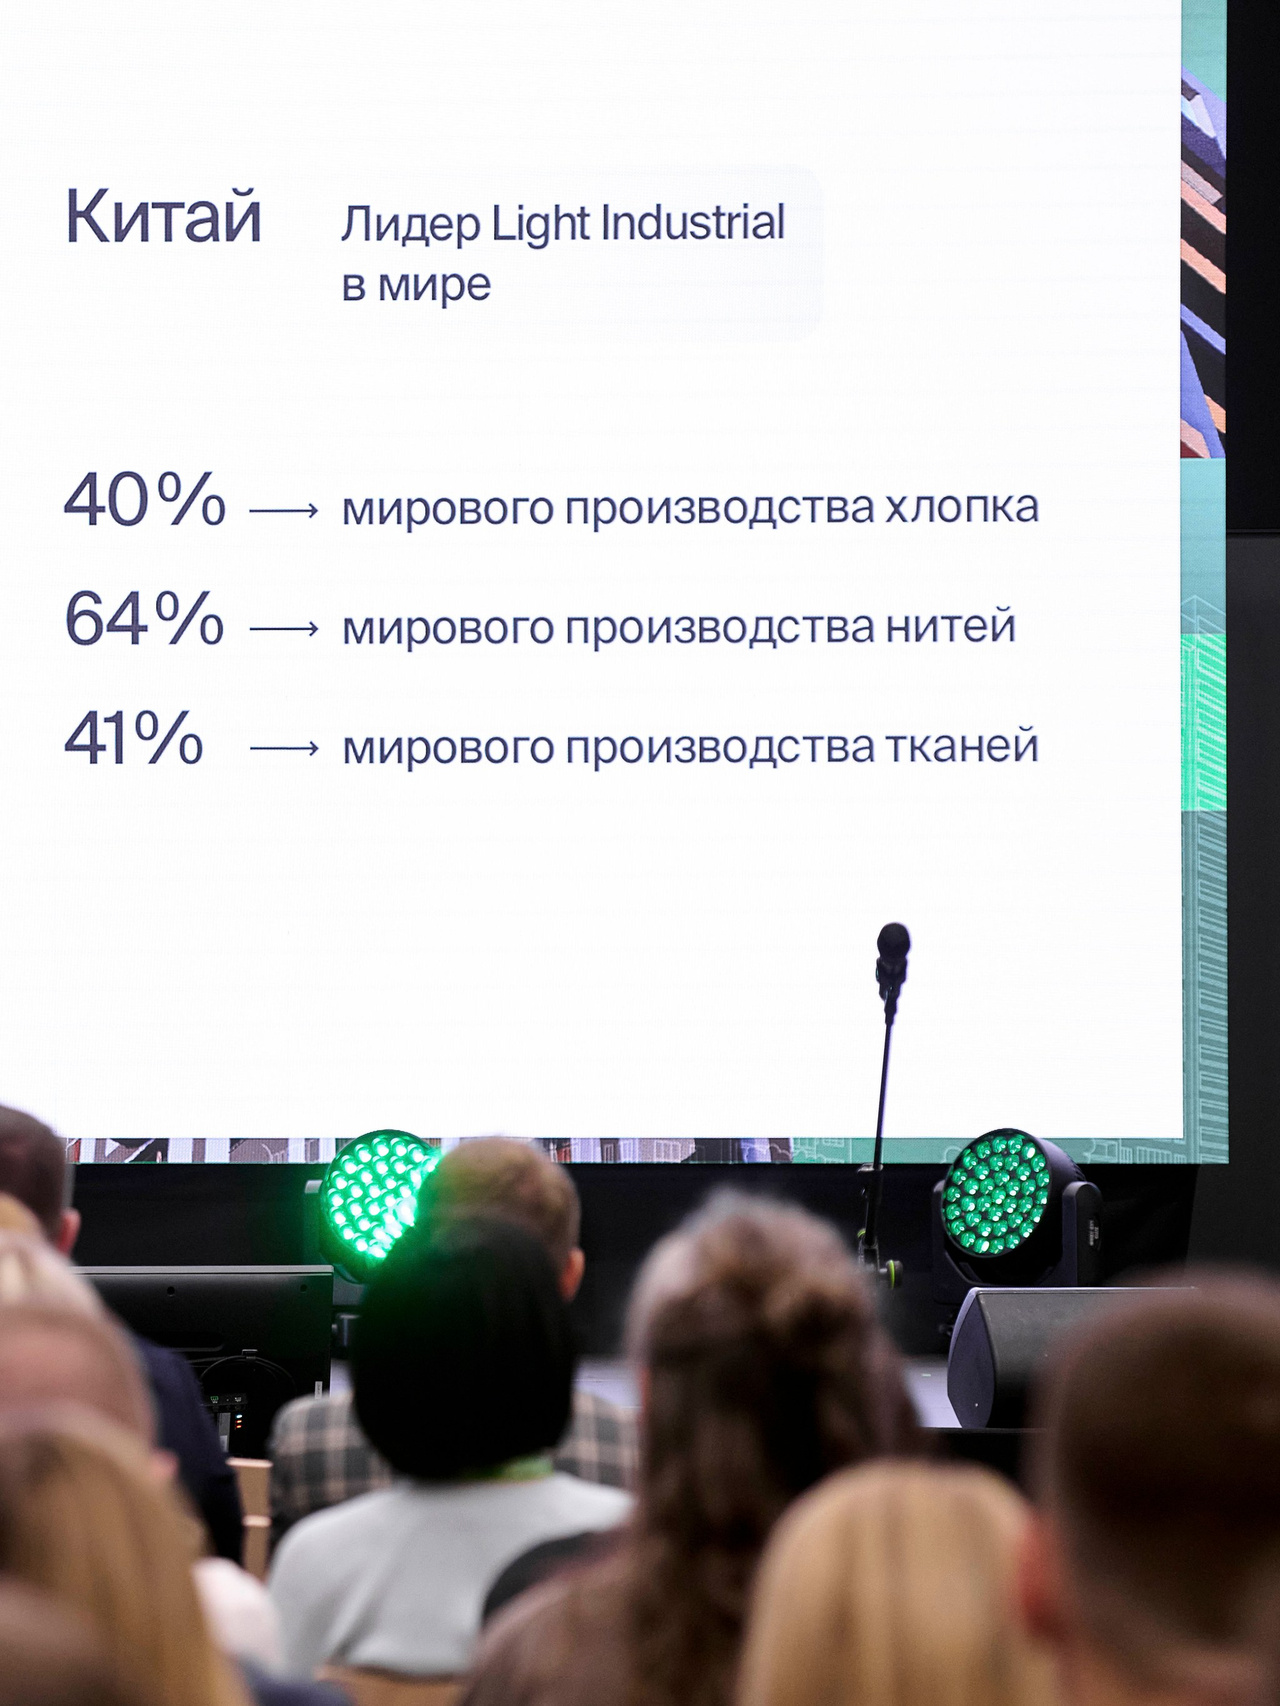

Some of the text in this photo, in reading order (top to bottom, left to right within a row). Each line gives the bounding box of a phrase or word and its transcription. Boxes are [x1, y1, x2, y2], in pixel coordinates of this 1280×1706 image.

[68, 187, 261, 243] Китай
[342, 202, 784, 249] Лидер Light Industrial
[343, 272, 491, 310] в мире
[64, 470, 1039, 534] 40% мирового производства хлопка
[66, 589, 1015, 653] 64% мирового производства нитей
[64, 709, 1038, 773] 41% мирового производства тканей
